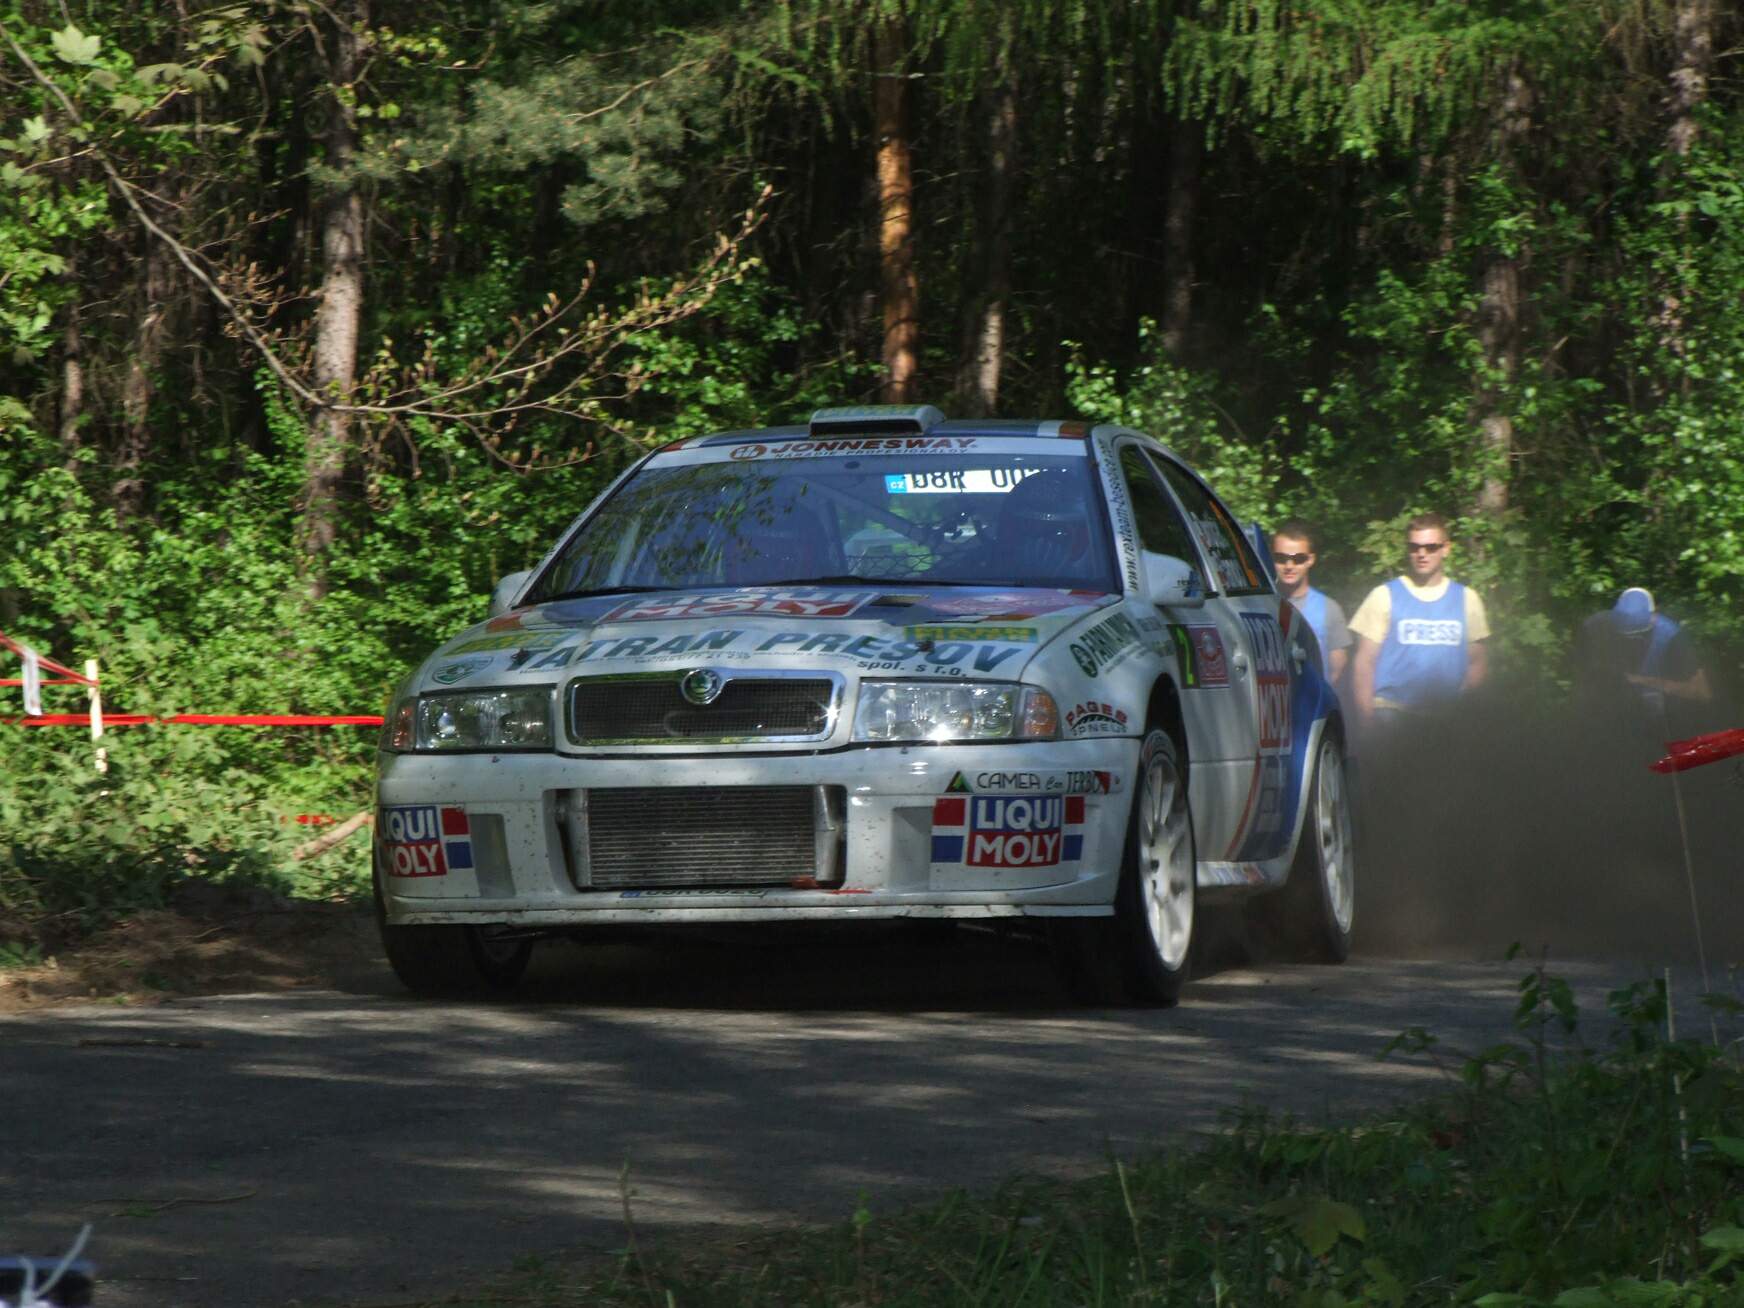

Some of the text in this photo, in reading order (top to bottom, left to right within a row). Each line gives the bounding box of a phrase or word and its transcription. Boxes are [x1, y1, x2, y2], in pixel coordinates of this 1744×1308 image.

[771, 438, 976, 453] JONNESWAY
[617, 602, 851, 616] MOLY
[635, 592, 872, 608] LIQUI
[1403, 622, 1460, 642] PRESS
[505, 630, 746, 672] TATRAN
[857, 660, 905, 672] spol.
[914, 664, 926, 673] s
[976, 799, 1059, 832] LIQUI
[383, 809, 437, 843] IQUI
[972, 833, 1060, 865] MOLY
